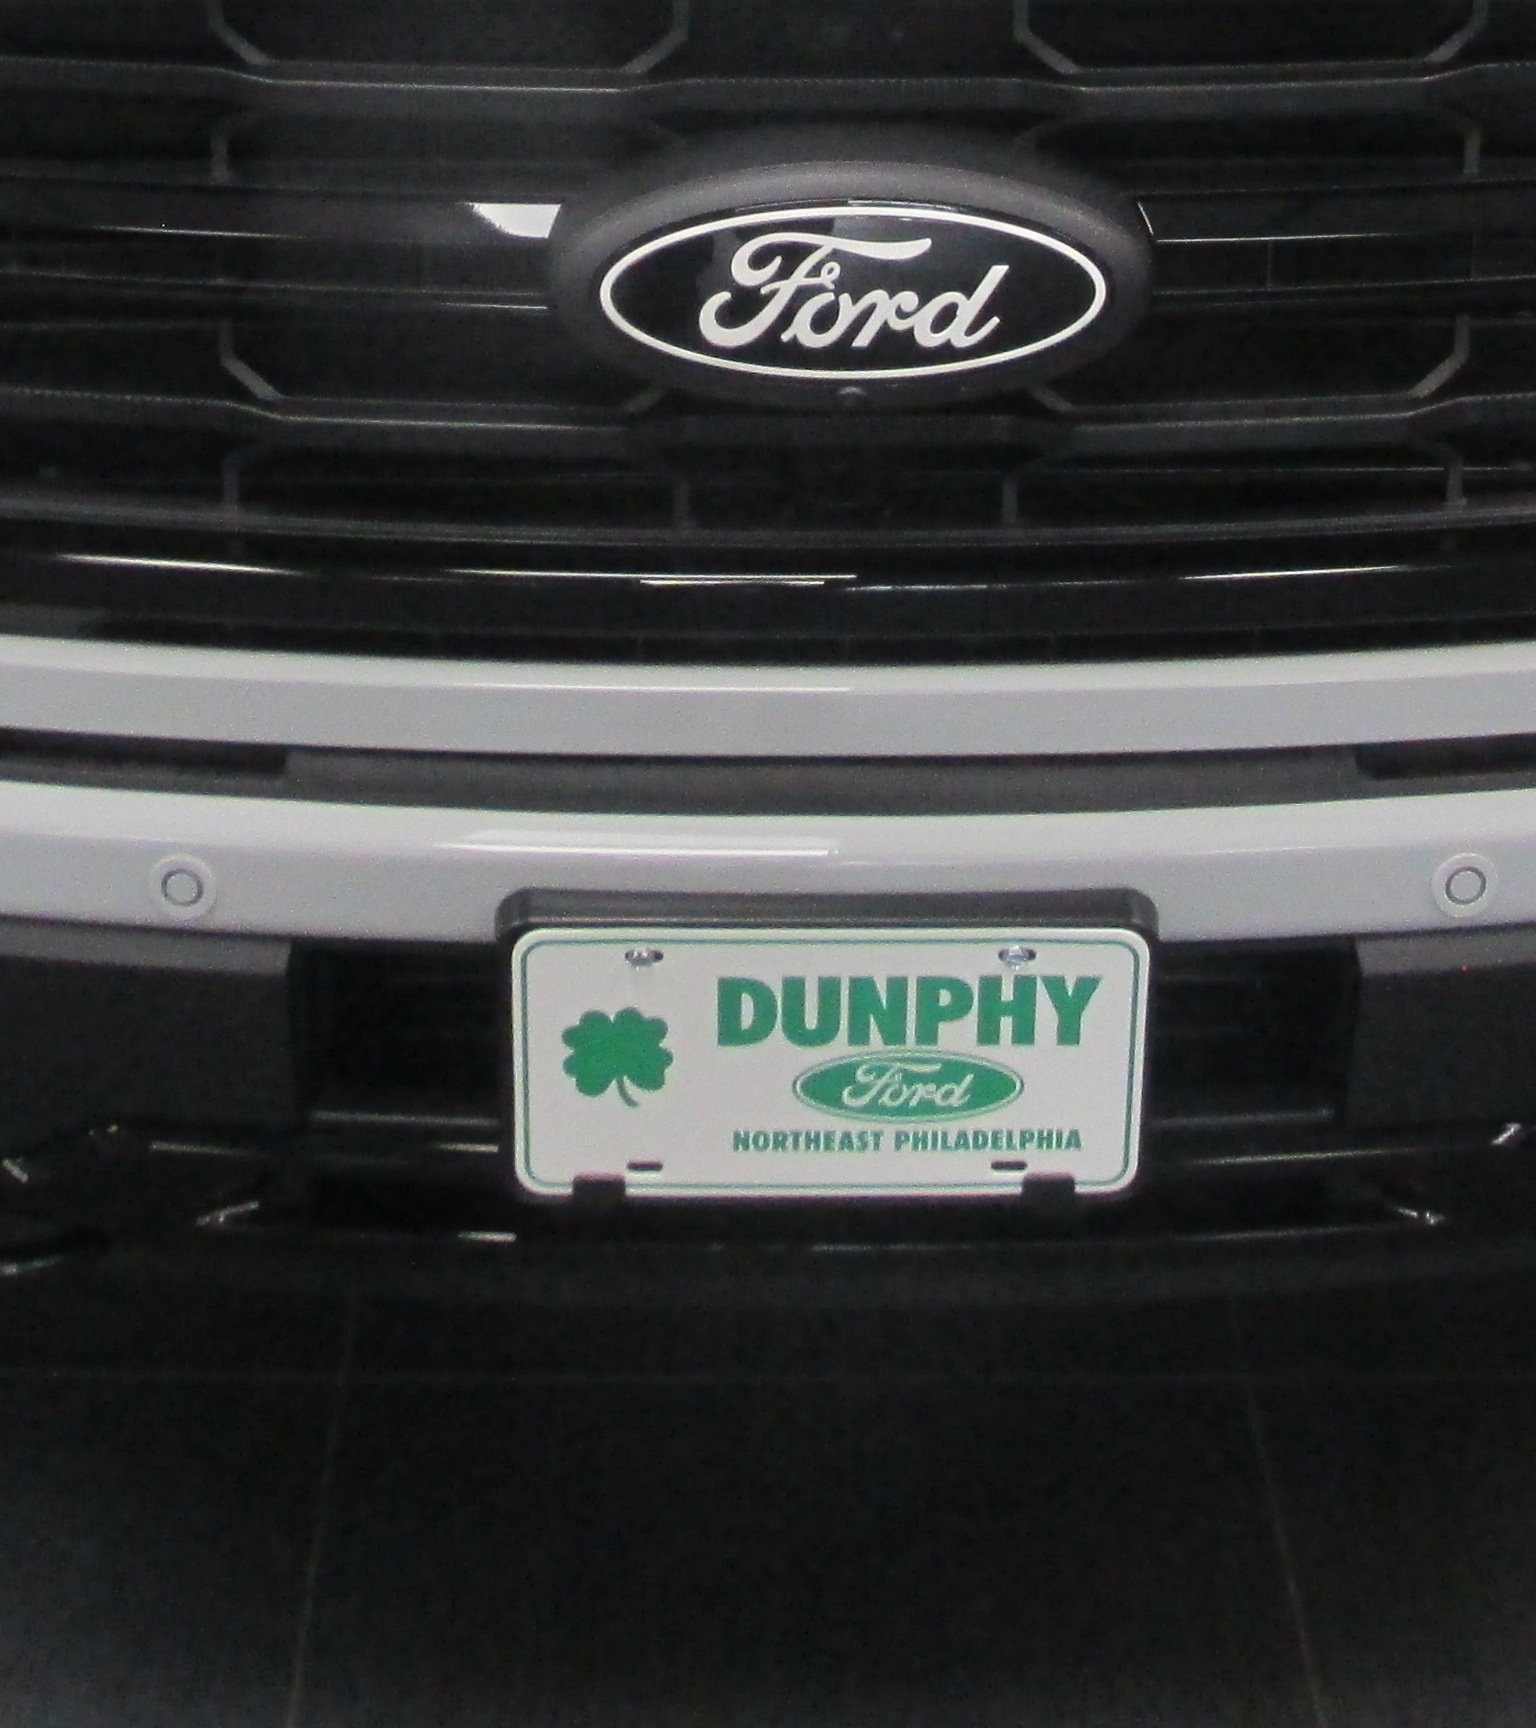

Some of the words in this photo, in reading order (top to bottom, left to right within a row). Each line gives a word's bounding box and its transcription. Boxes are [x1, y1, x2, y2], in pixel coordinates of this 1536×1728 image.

[698, 231, 1010, 349] Ford
[716, 975, 1103, 1048] DUNPHY
[841, 1061, 975, 1108] Ford
[732, 1129, 884, 1153] NORTHEAST
[894, 1128, 1083, 1152] PHILADELPHIA
